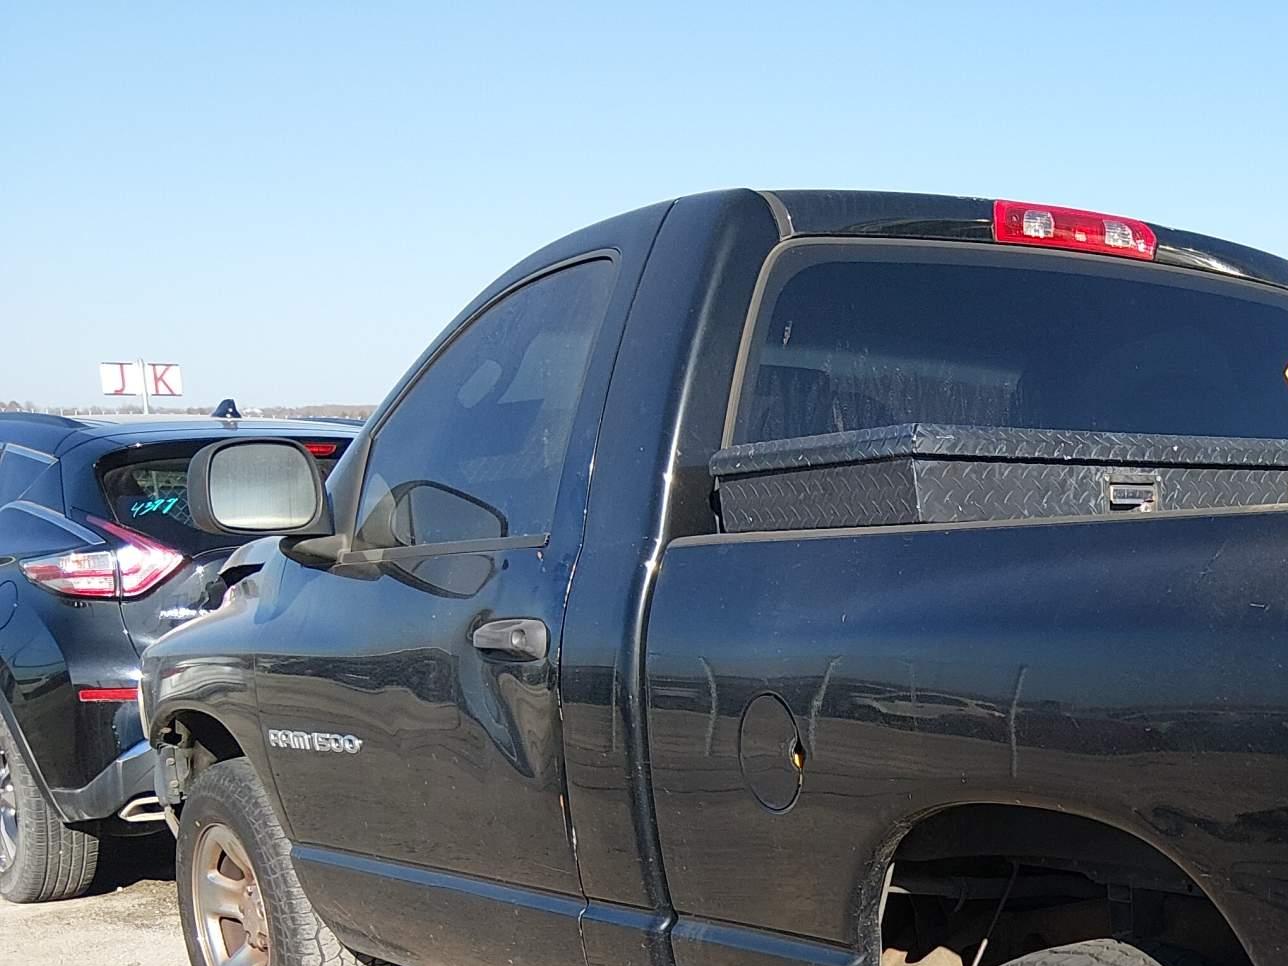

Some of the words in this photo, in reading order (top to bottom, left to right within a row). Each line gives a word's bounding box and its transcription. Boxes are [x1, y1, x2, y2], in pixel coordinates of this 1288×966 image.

[114, 363, 126, 395] J
[152, 363, 177, 396] K
[268, 729, 311, 750] RAM
[311, 732, 363, 754] 1500
